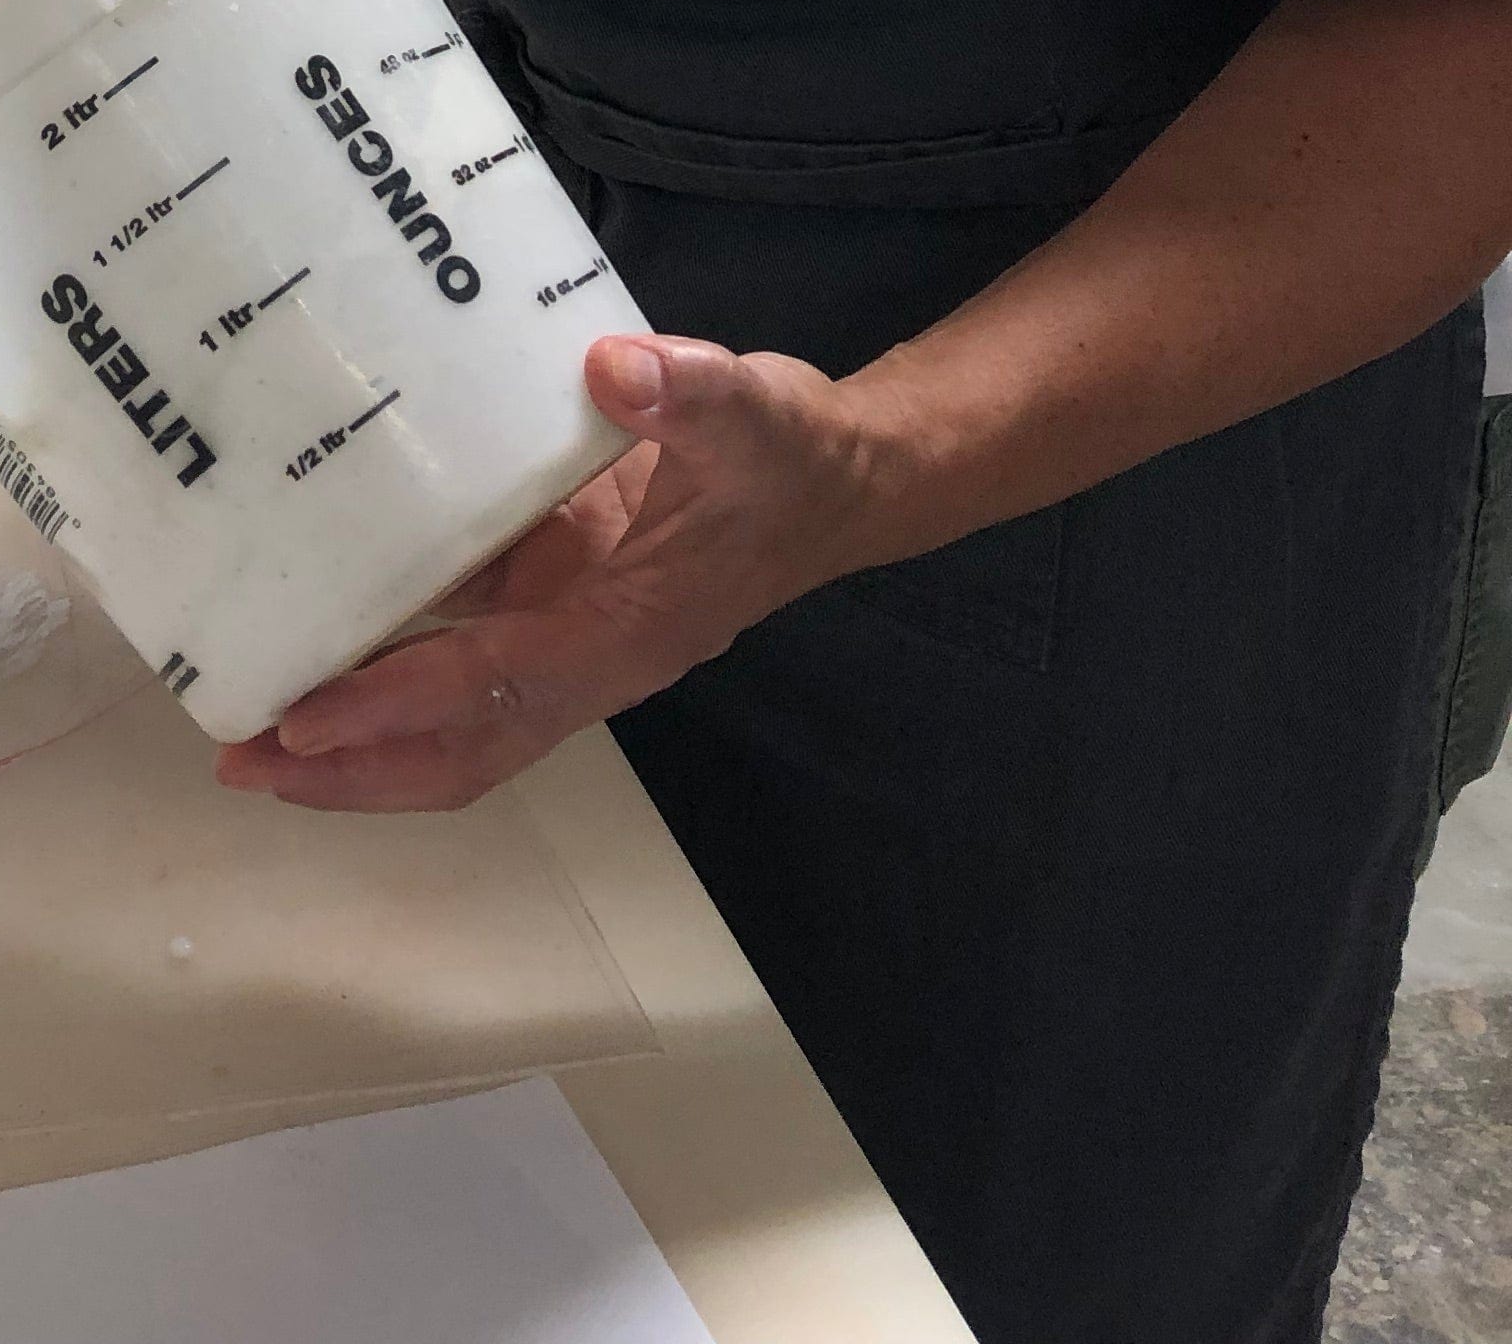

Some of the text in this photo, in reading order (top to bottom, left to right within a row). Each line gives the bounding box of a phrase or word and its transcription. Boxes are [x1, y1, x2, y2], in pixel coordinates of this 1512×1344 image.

[380, 47, 420, 75] 48 oz
[41, 93, 99, 150] 2 ltr
[295, 54, 481, 304] OUNCES
[451, 164, 476, 186] 32
[475, 156, 493, 174] oz
[92, 194, 174, 268] 1 1/2 ltr
[536, 286, 557, 308] 16
[556, 278, 574, 295] oz
[199, 301, 254, 352] 1 ltr
[41, 273, 218, 489] LITERS
[285, 426, 347, 482] 1/2 ltr
